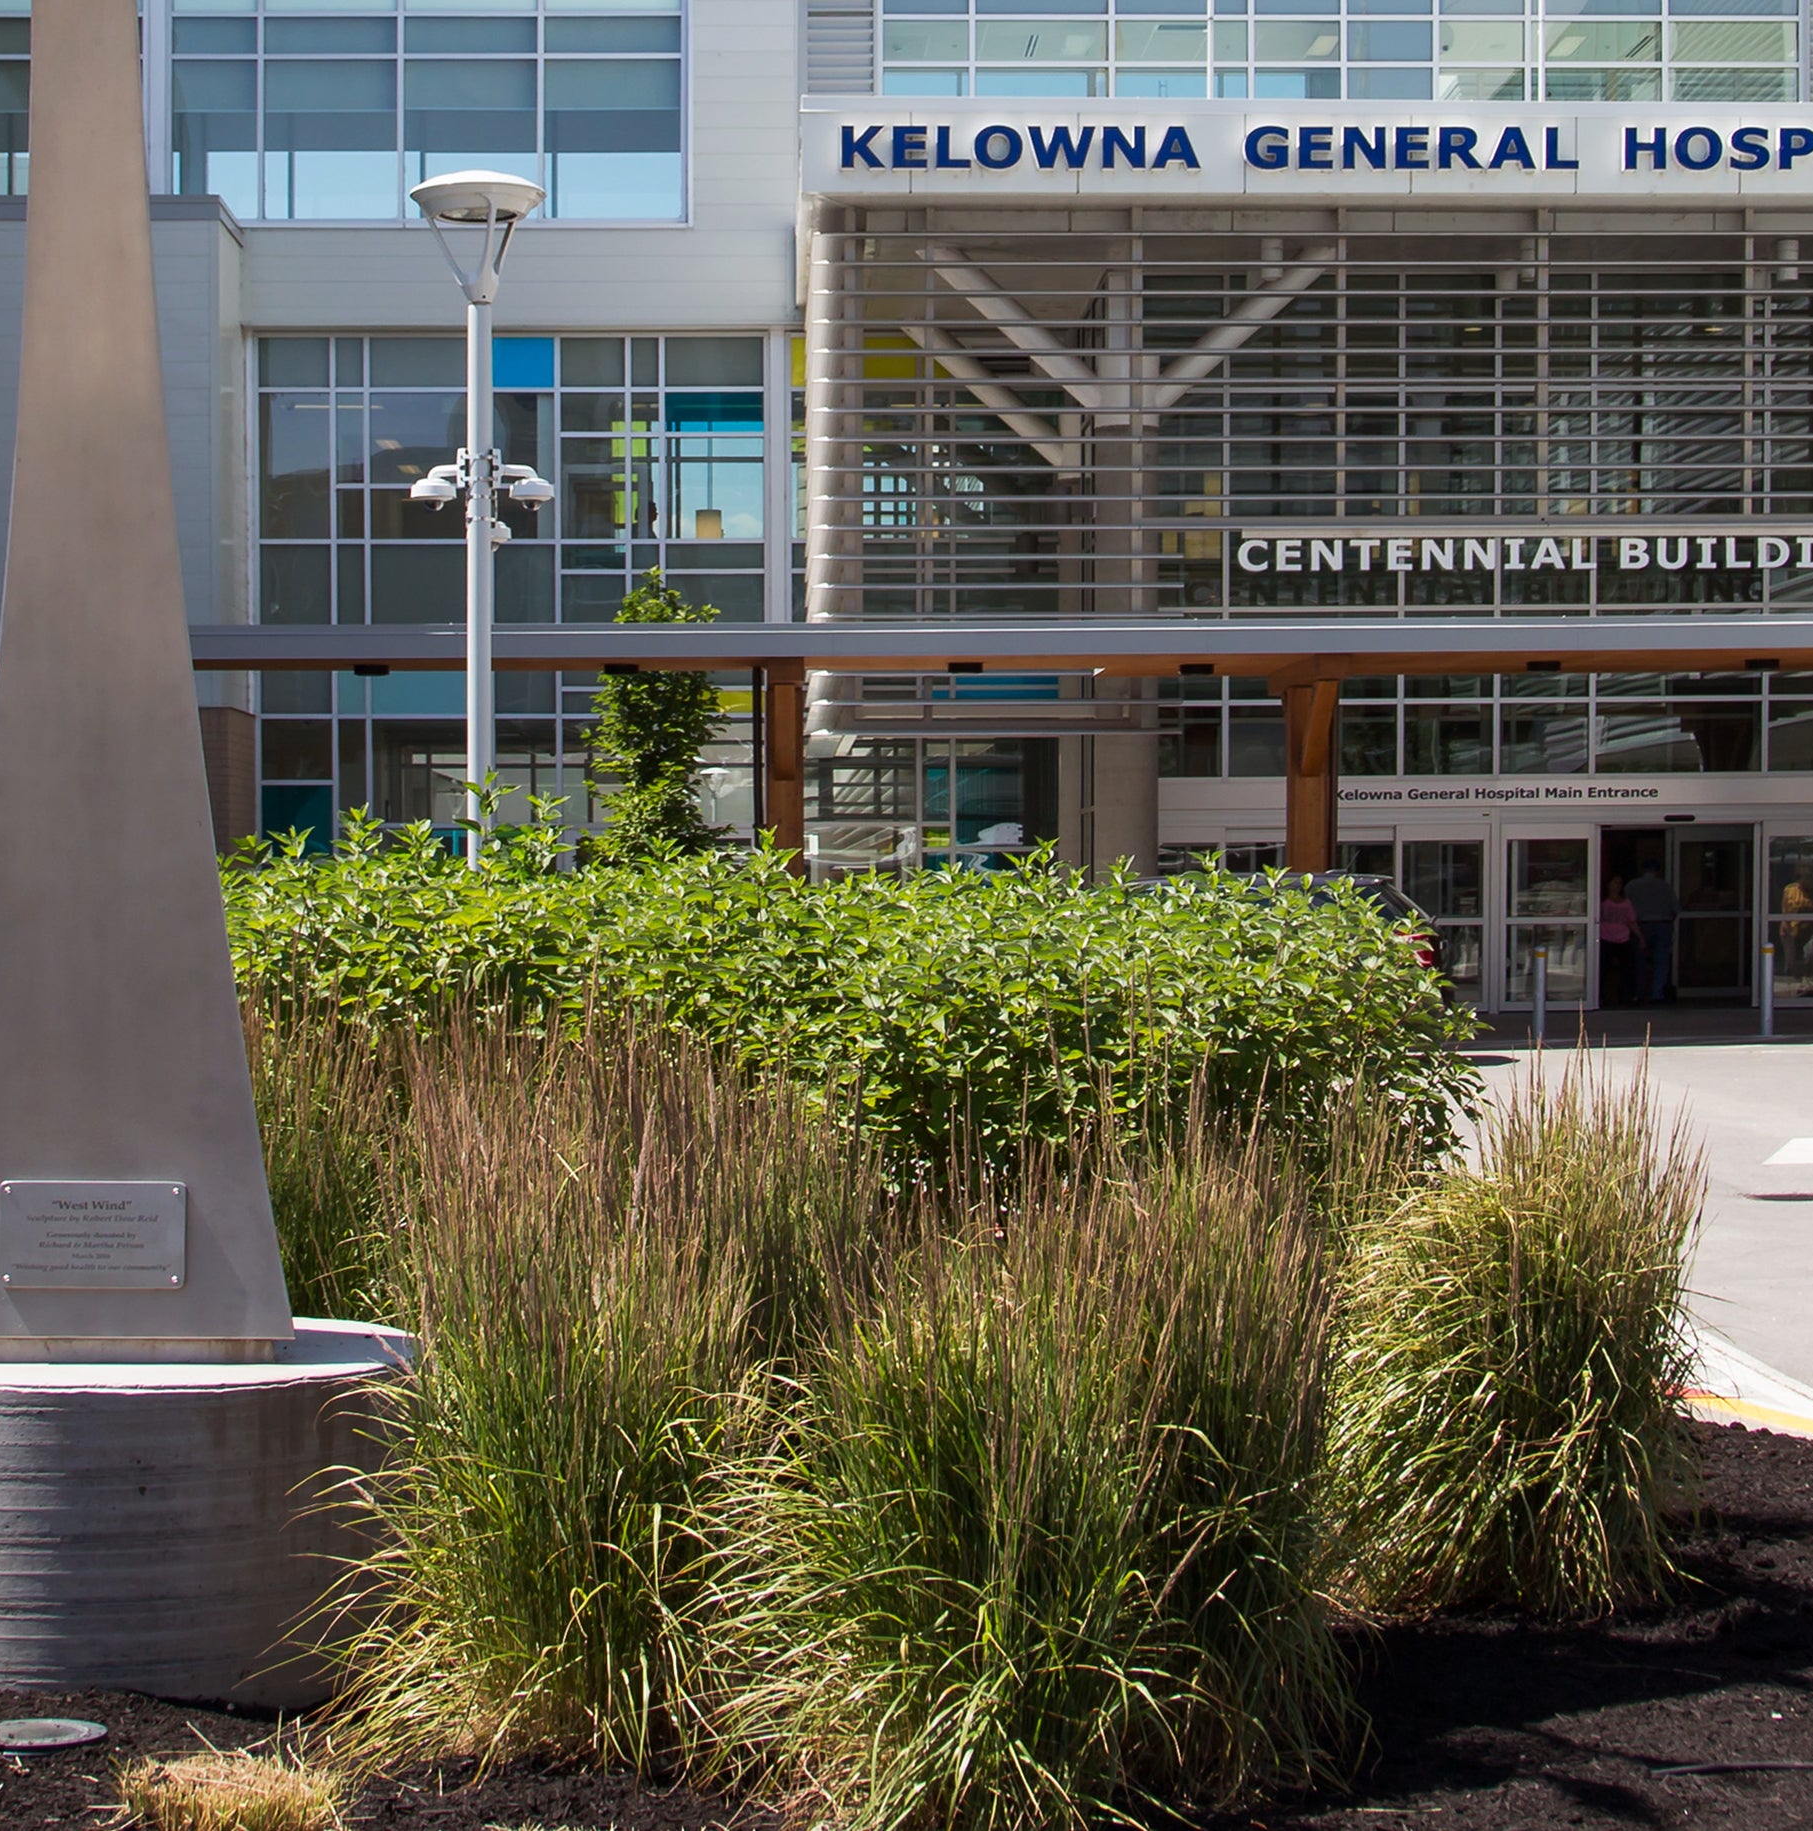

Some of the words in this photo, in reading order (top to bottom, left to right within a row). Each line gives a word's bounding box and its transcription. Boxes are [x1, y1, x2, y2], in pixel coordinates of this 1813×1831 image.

[839, 124, 1201, 171] KELOWNA
[1245, 124, 1579, 171] GENERAL
[1237, 536, 1598, 572] CENTENNIAL
[1336, 788, 1403, 801] Kelowna
[1407, 787, 1470, 801] General
[1474, 786, 1539, 802] Hospital
[1544, 786, 1583, 799] Main
[1587, 786, 1659, 799] Entrance
[69, 1215, 80, 1223] by
[126, 1232, 137, 1240] by
[38, 1241, 71, 1249] Richard
